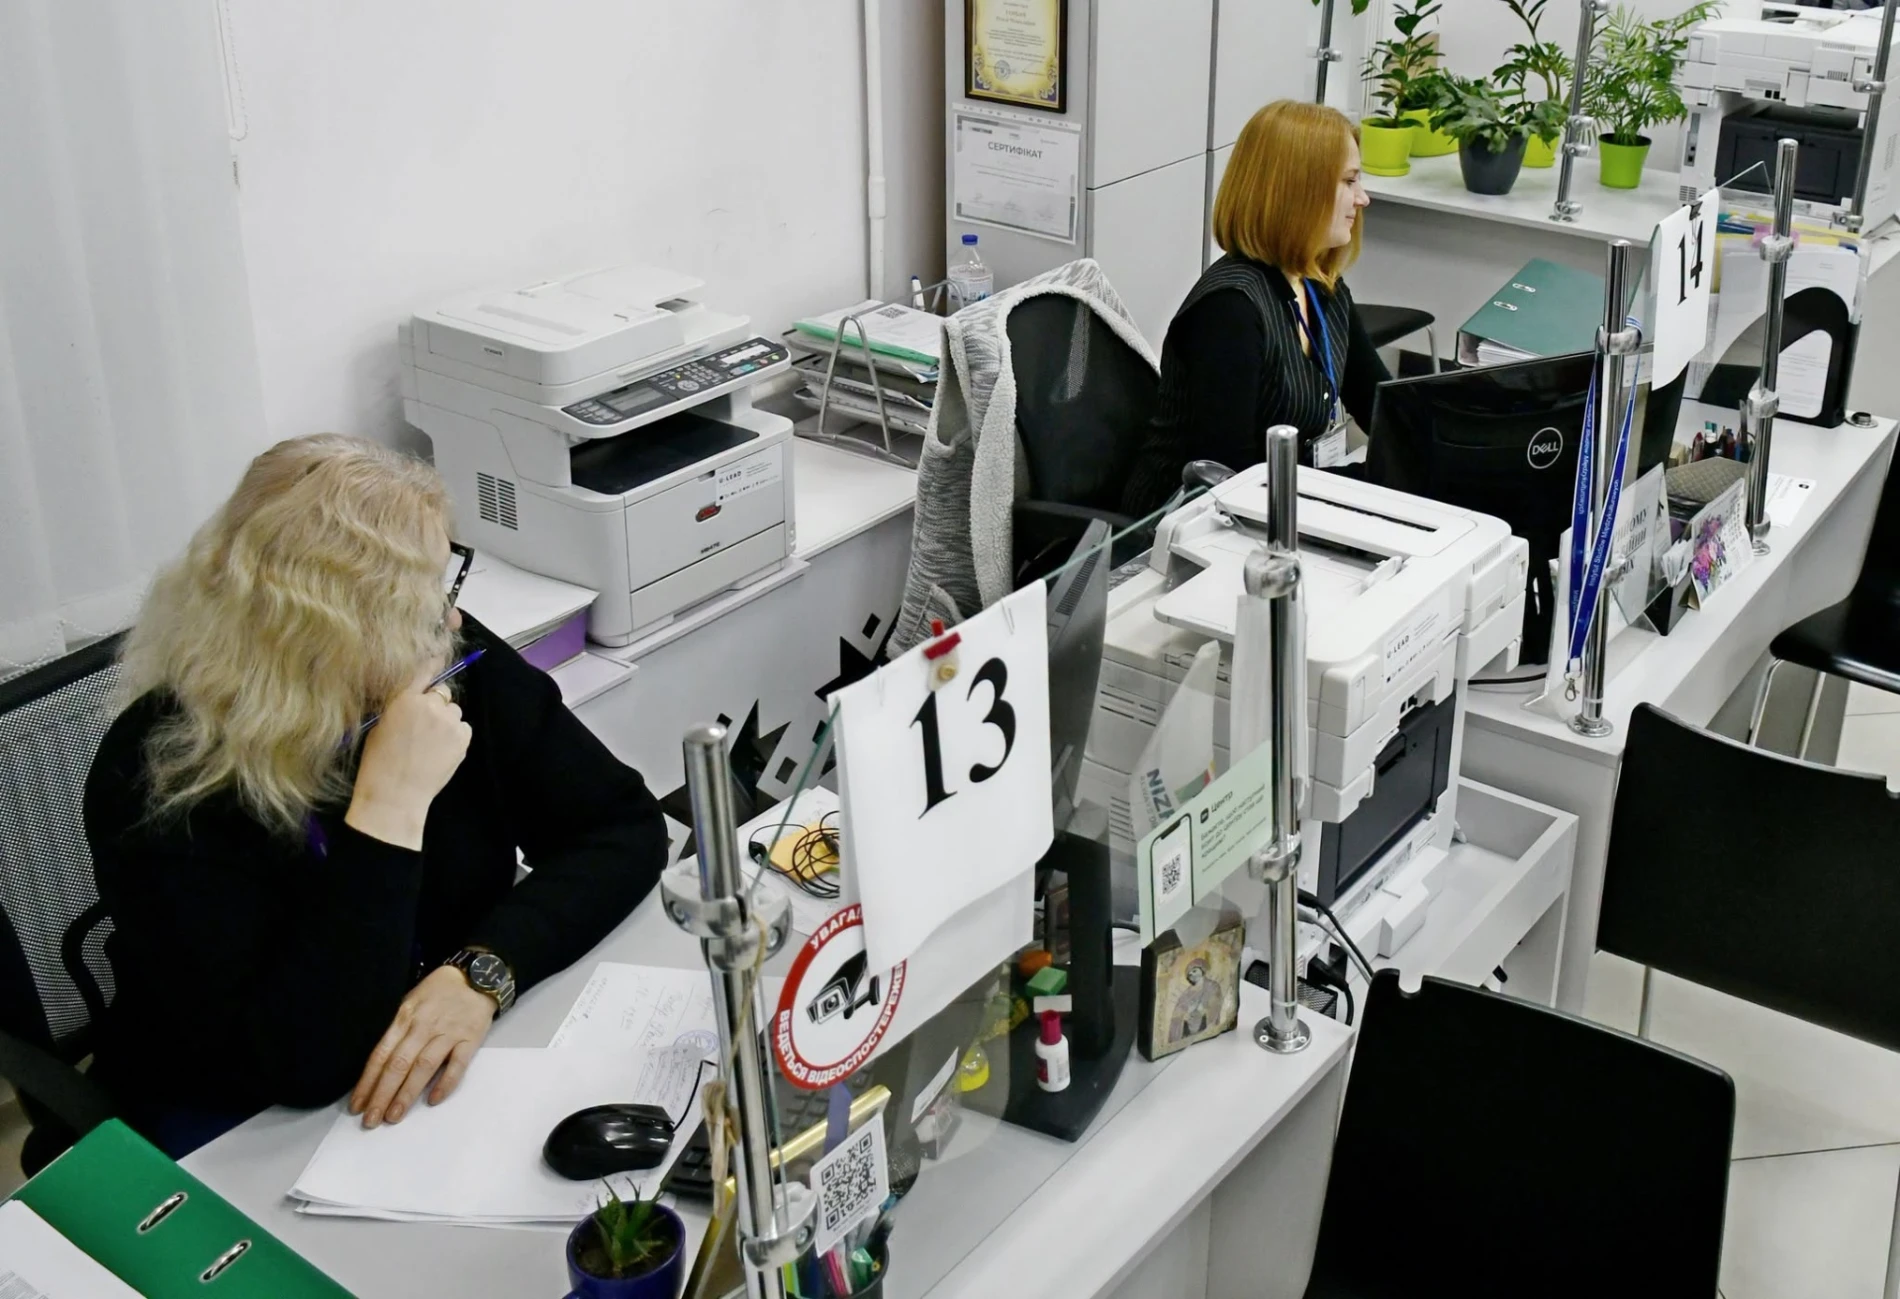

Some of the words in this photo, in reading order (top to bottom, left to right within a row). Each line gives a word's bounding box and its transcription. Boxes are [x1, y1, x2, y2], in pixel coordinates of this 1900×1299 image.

[988, 141, 1043, 159] СЕРТИФІКАТ
[1677, 219, 1703, 306] 14
[1532, 441, 1559, 455] DELL
[1594, 539, 1606, 564] Studiów
[1600, 479, 1620, 539] Międzykulturowych
[909, 657, 1016, 819] 13
[810, 907, 862, 950] УВАГА!
[777, 1009, 808, 1083] ВЕДЕТЬСЯ
